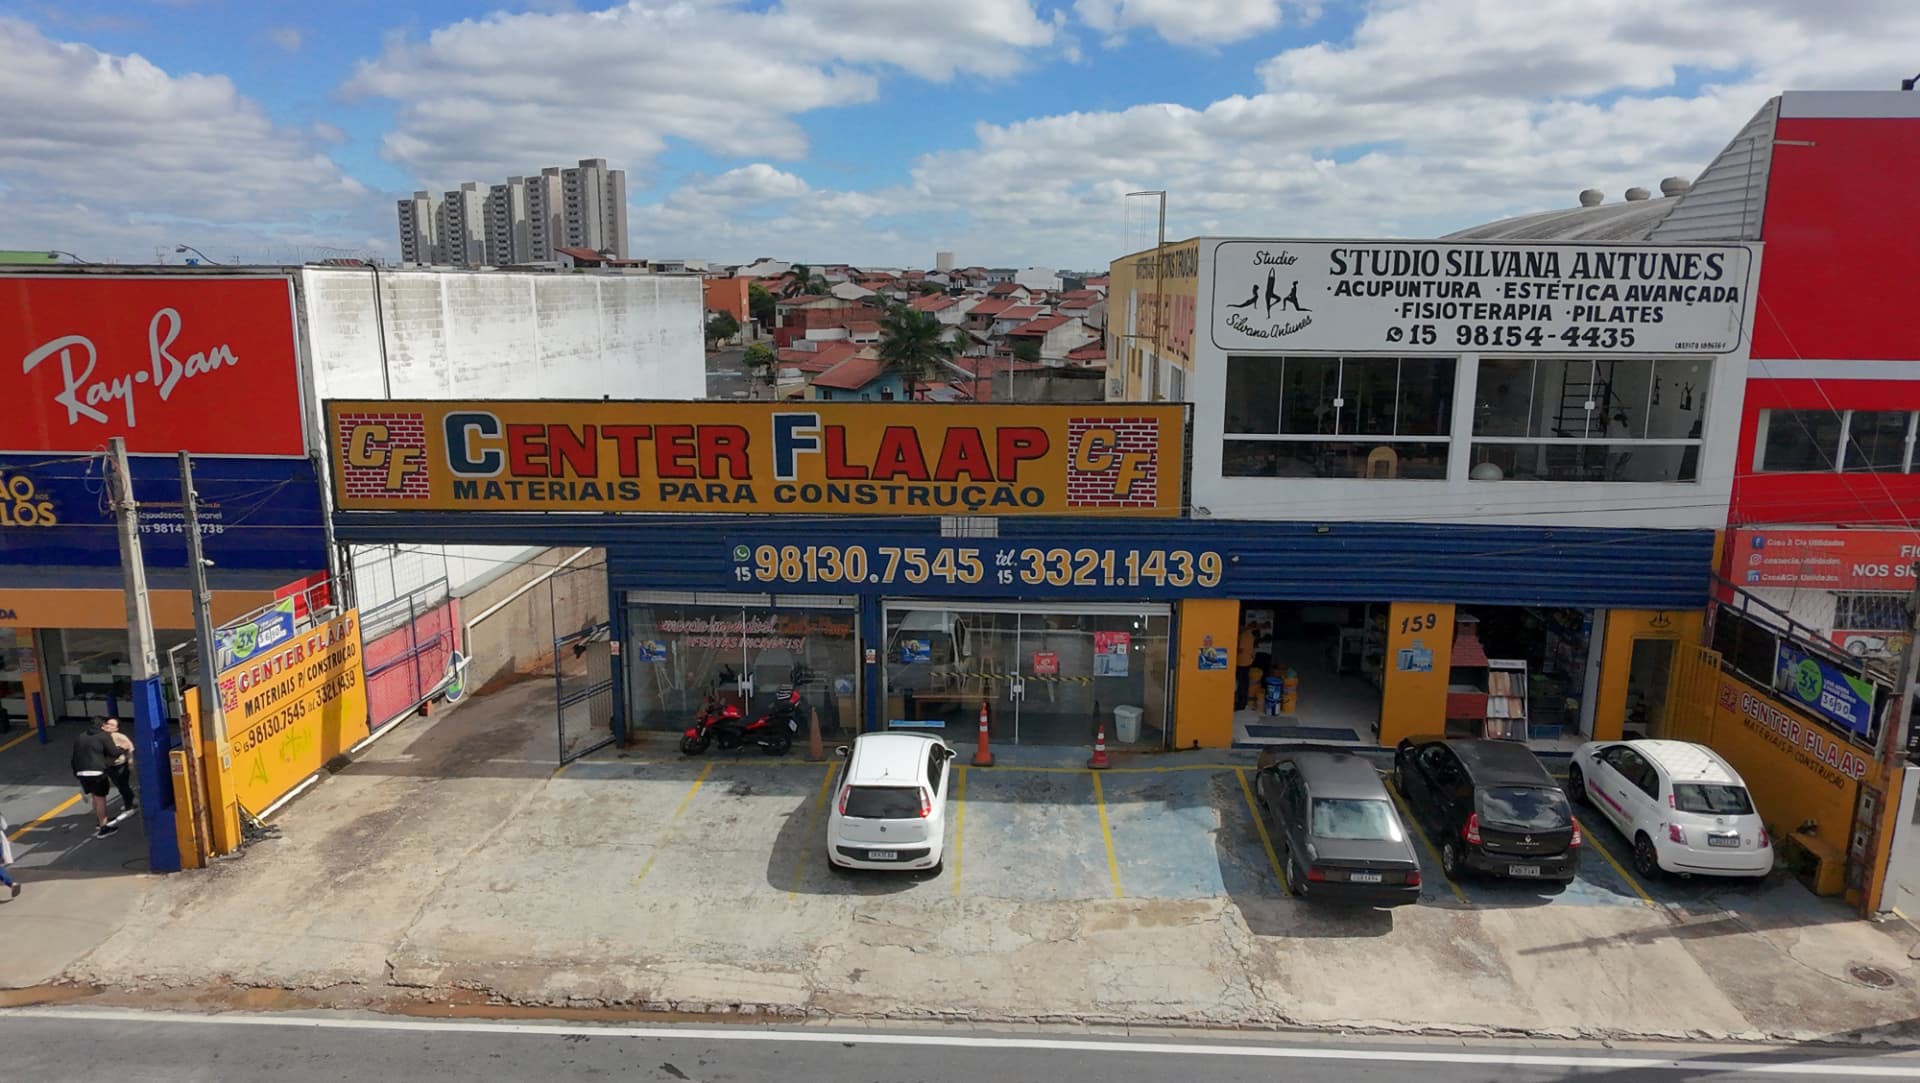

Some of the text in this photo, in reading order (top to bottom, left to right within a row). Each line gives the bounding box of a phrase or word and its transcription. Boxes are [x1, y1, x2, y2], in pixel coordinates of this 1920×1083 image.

[1253, 250, 1298, 266] Studio
[1329, 248, 1725, 281] STUDIO SILVANA ANTUNES
[1624, 285, 1739, 306] AVANÇADA
[1226, 313, 1270, 338] Silvana
[1408, 324, 1636, 348] 15 98154-4435
[442, 410, 1050, 483] CENTER FLAAP
[453, 480, 1046, 511] MATERIAIS PARA CONSTRUÇÃO
[734, 544, 985, 584] 15 98130.7545
[997, 548, 1223, 588] 15 3321.1439
[1852, 564, 1889, 577] NOS
[1401, 612, 1437, 635] 159
[237, 618, 354, 694] CENTER FLAAP
[244, 676, 296, 719] MATERIAIS
[248, 700, 306, 749] 98130.7545
[1740, 692, 1866, 781] CENTER FLAAP
